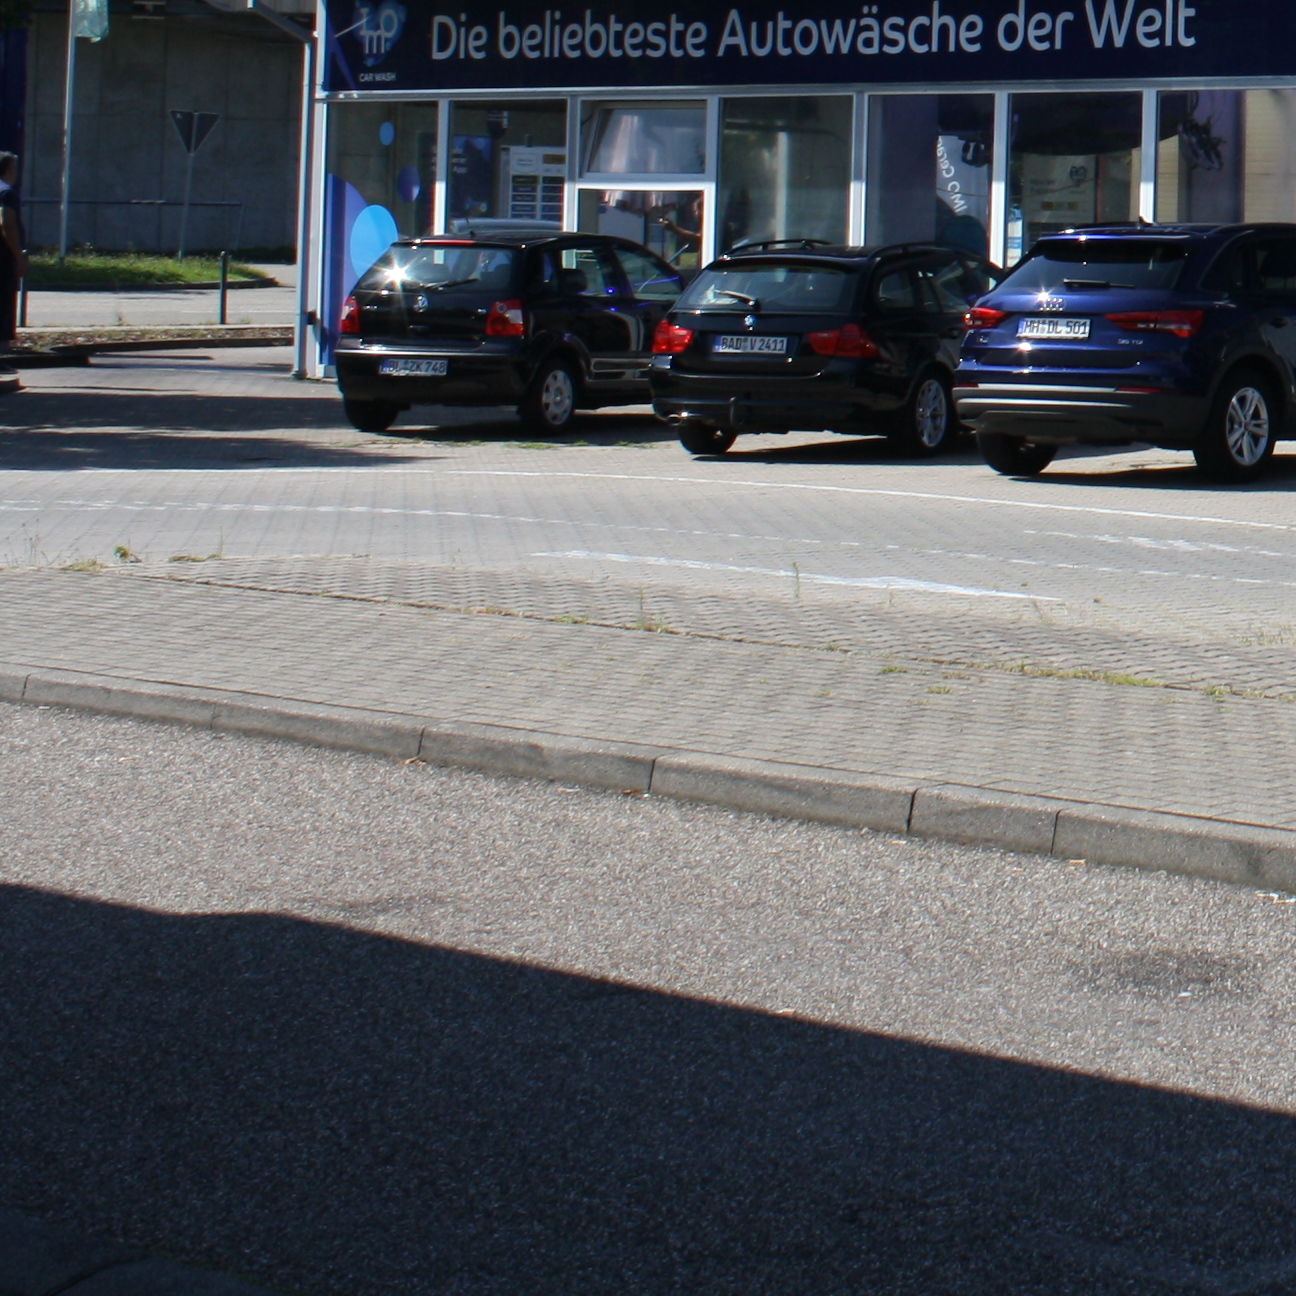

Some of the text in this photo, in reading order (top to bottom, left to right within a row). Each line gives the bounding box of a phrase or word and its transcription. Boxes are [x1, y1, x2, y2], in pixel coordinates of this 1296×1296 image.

[431, 12, 489, 61] Die
[497, 8, 708, 59] beliebteste
[716, 0, 984, 56] Autowäsche
[359, 72, 397, 83] CAR WASH
